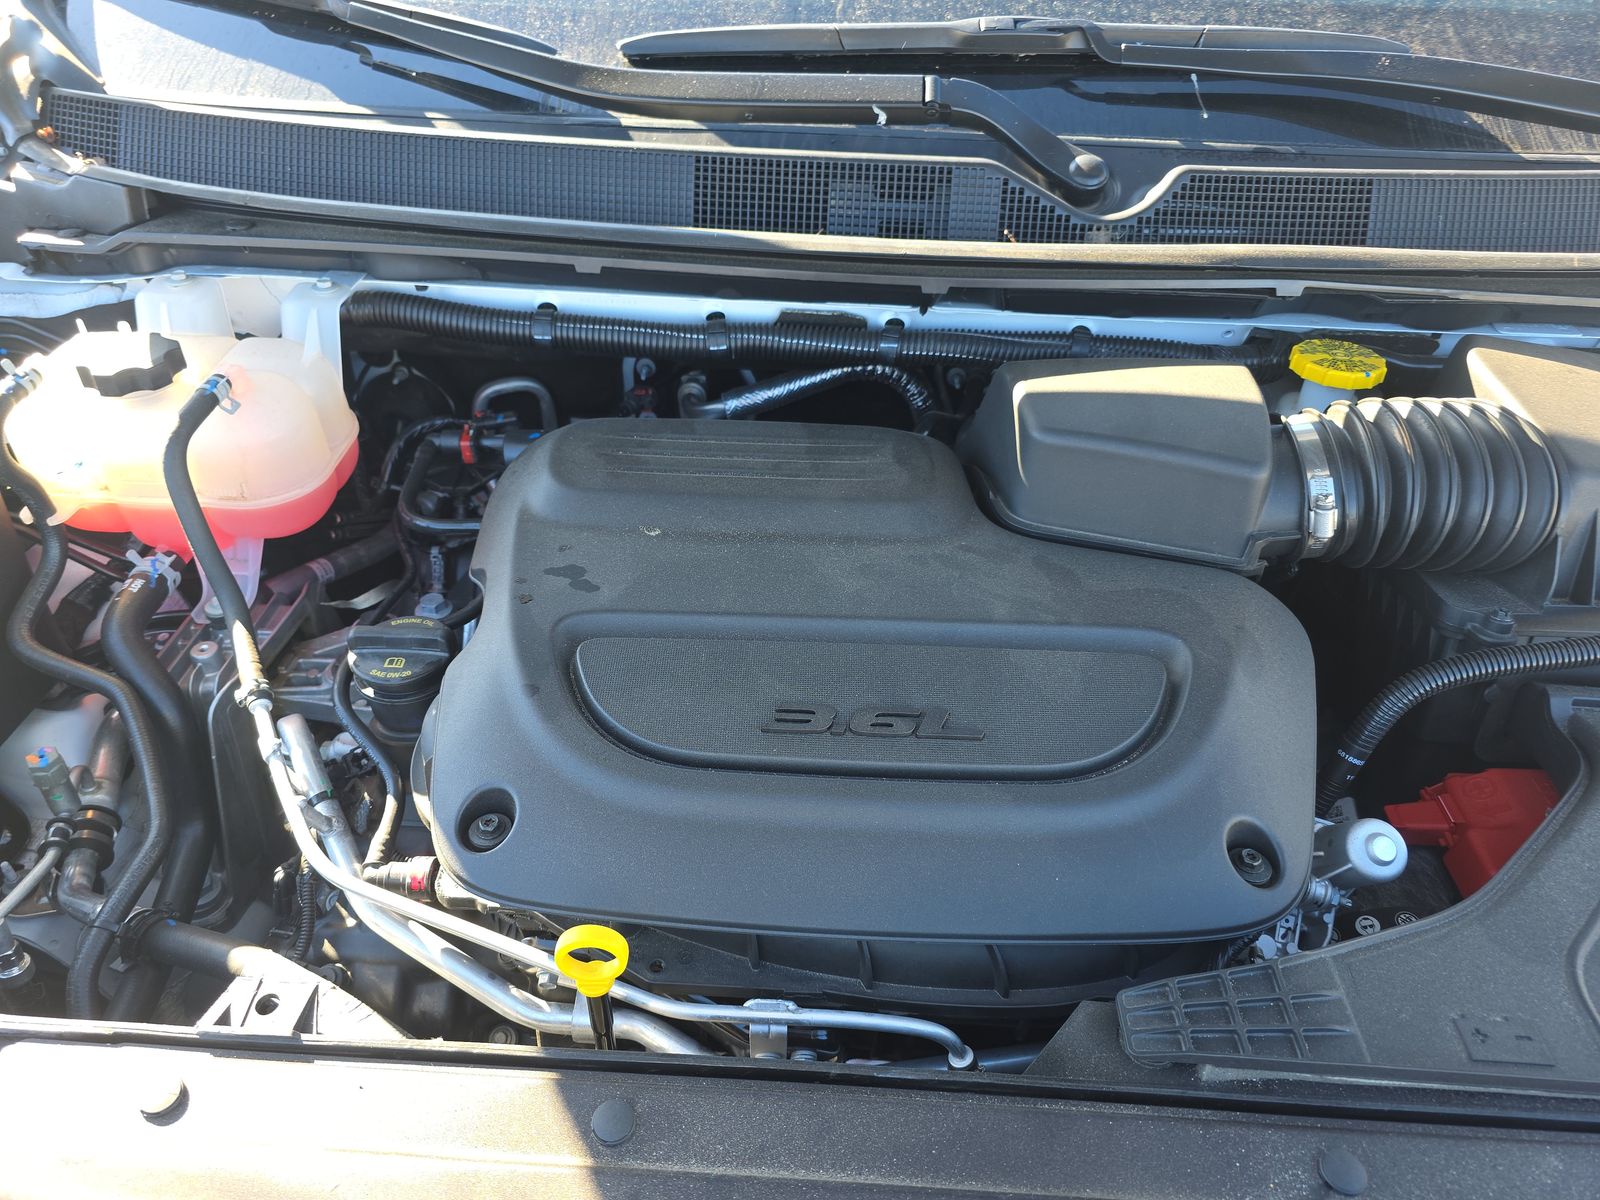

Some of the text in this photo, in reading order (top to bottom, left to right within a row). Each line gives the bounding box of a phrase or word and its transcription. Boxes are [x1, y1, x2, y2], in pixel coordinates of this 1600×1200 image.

[390, 618, 435, 627] ENGINE OIL
[369, 668, 386, 678] SAE
[760, 703, 985, 741] 3.6L
